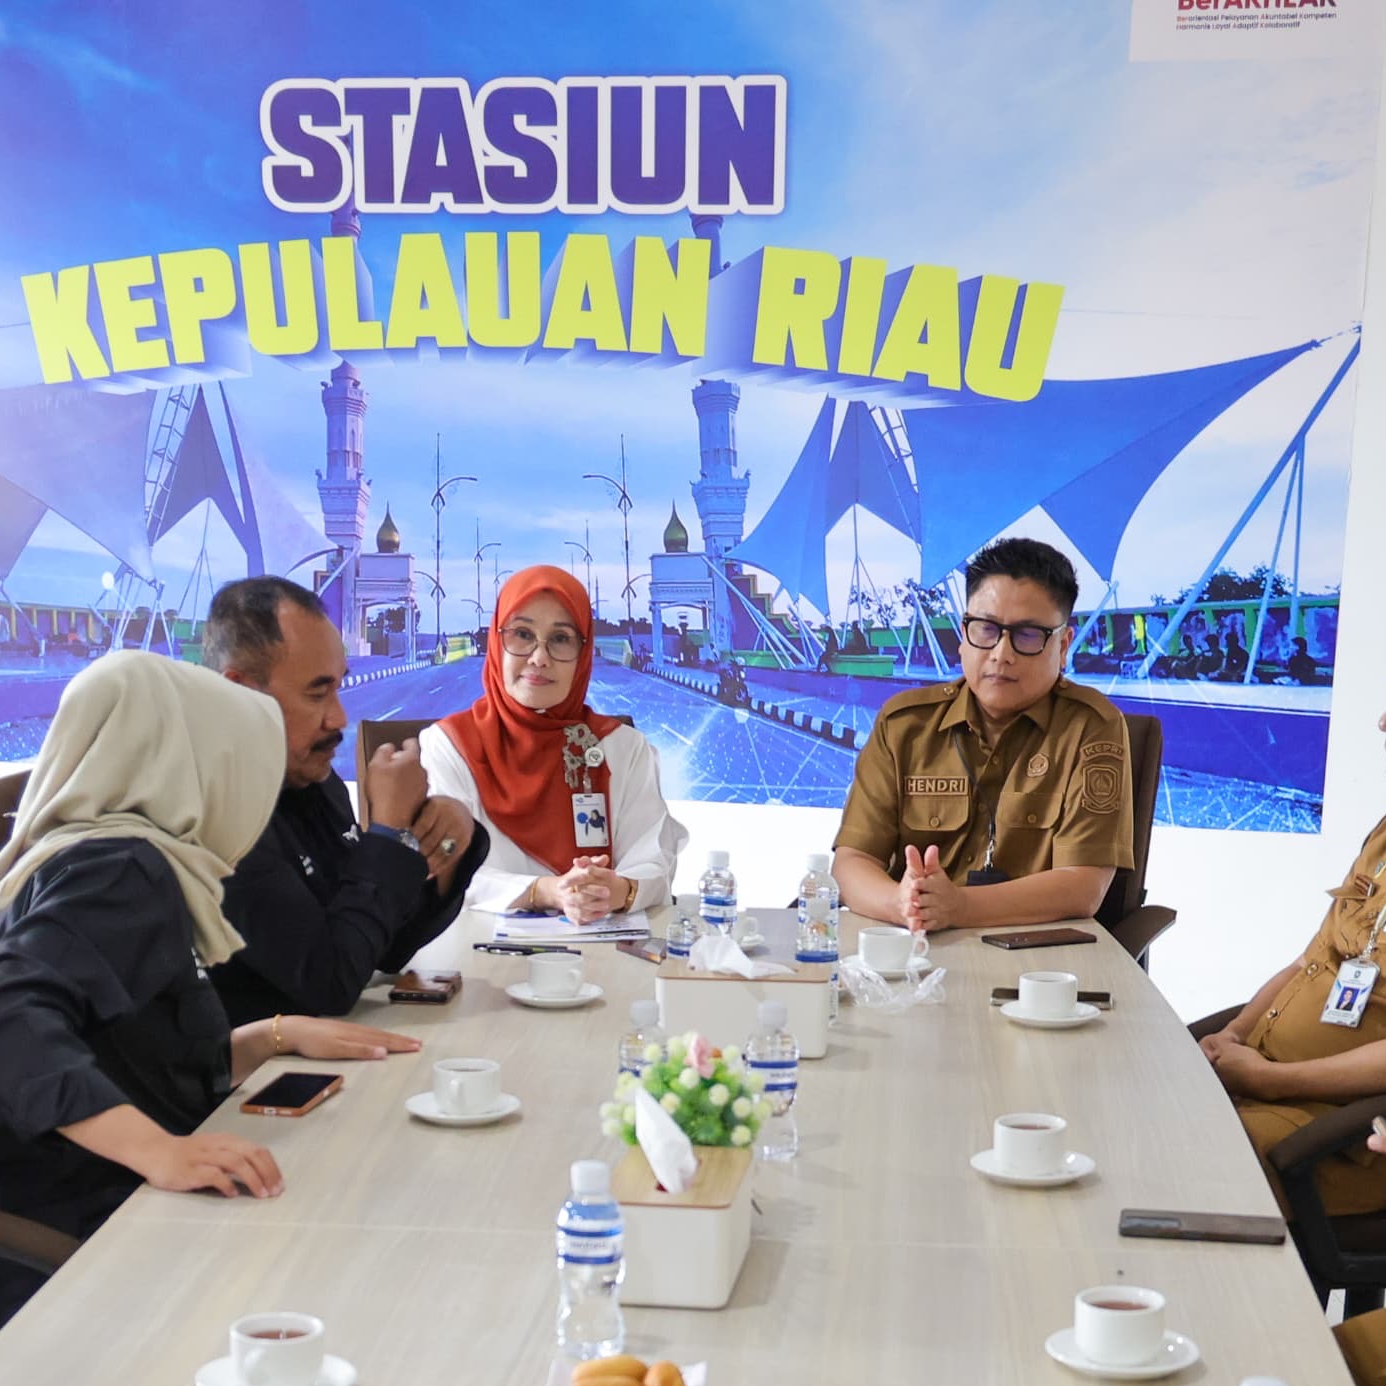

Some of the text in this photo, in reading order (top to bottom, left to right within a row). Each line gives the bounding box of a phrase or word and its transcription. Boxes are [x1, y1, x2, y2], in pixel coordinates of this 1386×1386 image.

[266, 83, 783, 209] STASIUN
[20, 231, 1066, 403] KEPULAUAN RIAU
[908, 778, 965, 792] HENDRI
